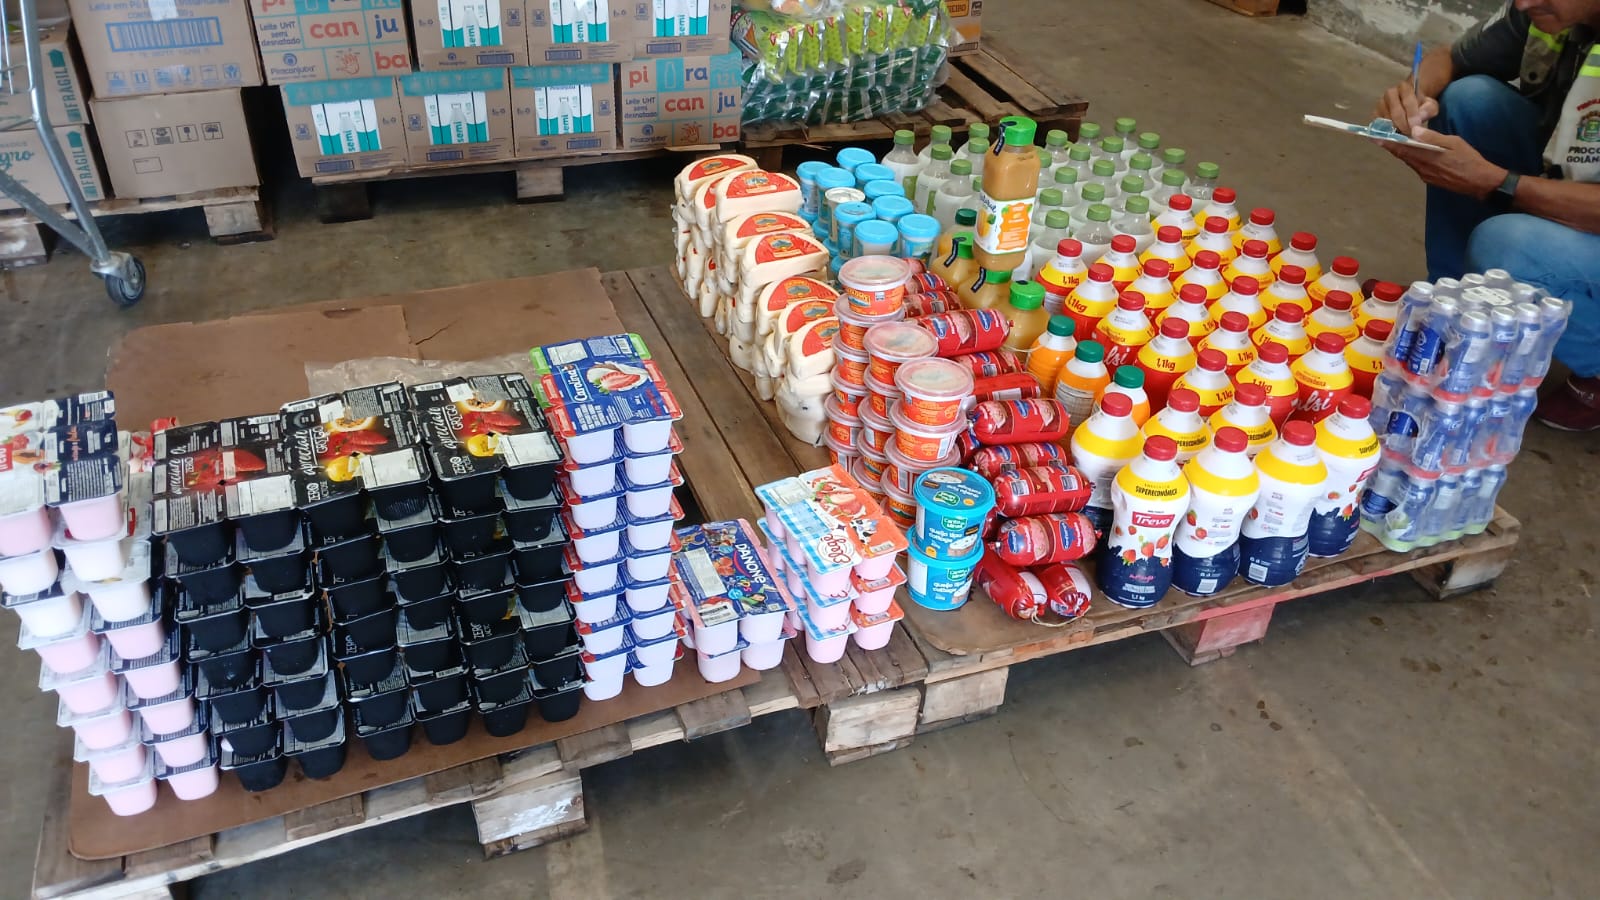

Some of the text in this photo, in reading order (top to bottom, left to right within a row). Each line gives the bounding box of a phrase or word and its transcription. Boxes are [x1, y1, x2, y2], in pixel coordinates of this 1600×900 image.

[310, 21, 359, 39] can
[374, 14, 399, 39] ju
[375, 51, 409, 70] ba
[629, 66, 649, 88] pi
[685, 67, 708, 81] ra
[664, 97, 704, 112] can
[717, 92, 736, 113] ju
[712, 122, 738, 139] ba
[1063, 276, 1080, 286] 1,1kg
[1068, 295, 1087, 312] 1,1kg
[1156, 358, 1175, 371] 1,1kg
[1135, 514, 1170, 526] Trevo
